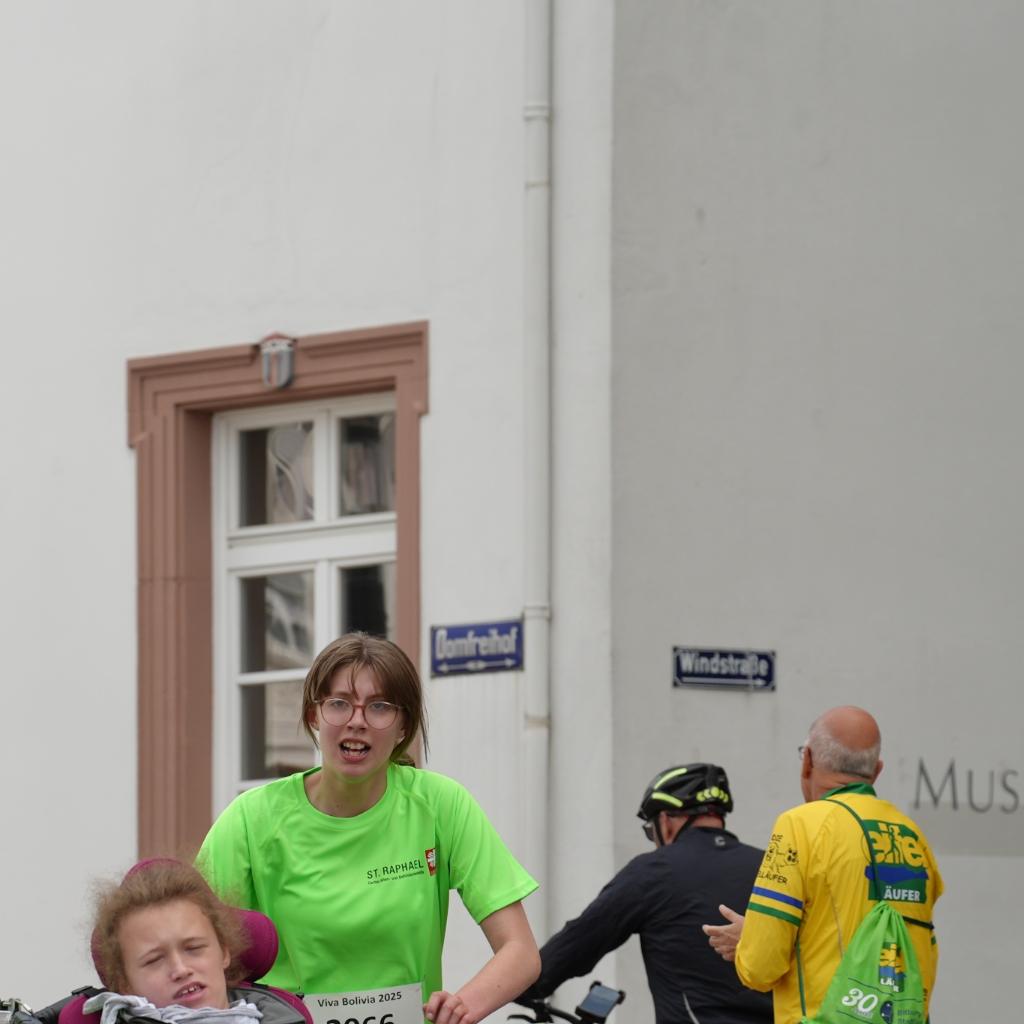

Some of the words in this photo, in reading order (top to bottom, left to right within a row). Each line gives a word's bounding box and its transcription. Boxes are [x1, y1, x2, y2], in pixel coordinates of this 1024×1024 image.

[436, 627, 517, 659] Domfreihof
[679, 651, 768, 677] Windstraße
[382, 859, 424, 876] RAPHAEL
[884, 885, 920, 901] ÄUFER
[317, 998, 339, 1008] Viva
[342, 996, 376, 1006] Bolivia
[378, 991, 402, 1003] 2025
[842, 988, 878, 1013] 30
